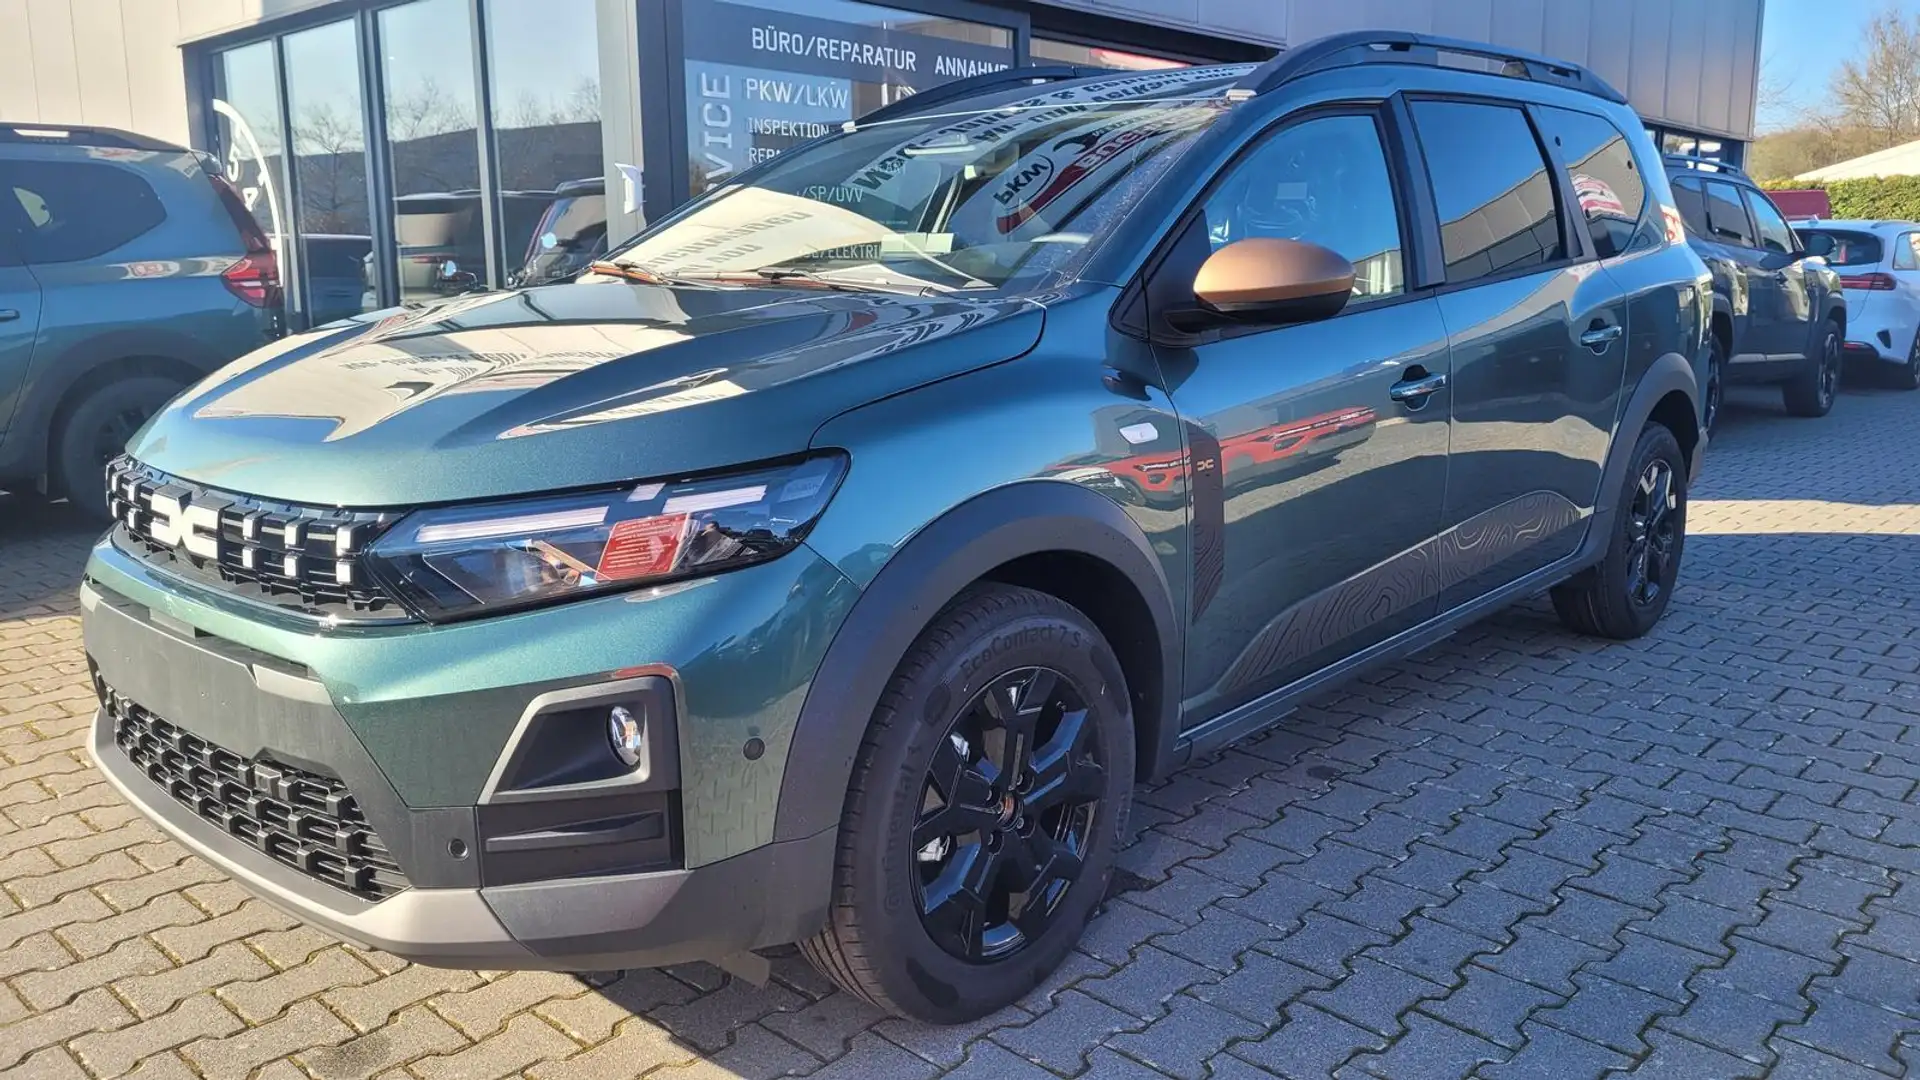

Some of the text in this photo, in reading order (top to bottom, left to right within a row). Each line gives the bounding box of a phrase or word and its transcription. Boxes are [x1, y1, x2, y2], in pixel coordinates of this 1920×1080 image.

[752, 25, 917, 72] BÜRO/REPARATUR
[746, 78, 848, 110] PKW/LKW
[749, 117, 830, 138] INSPEKTION
